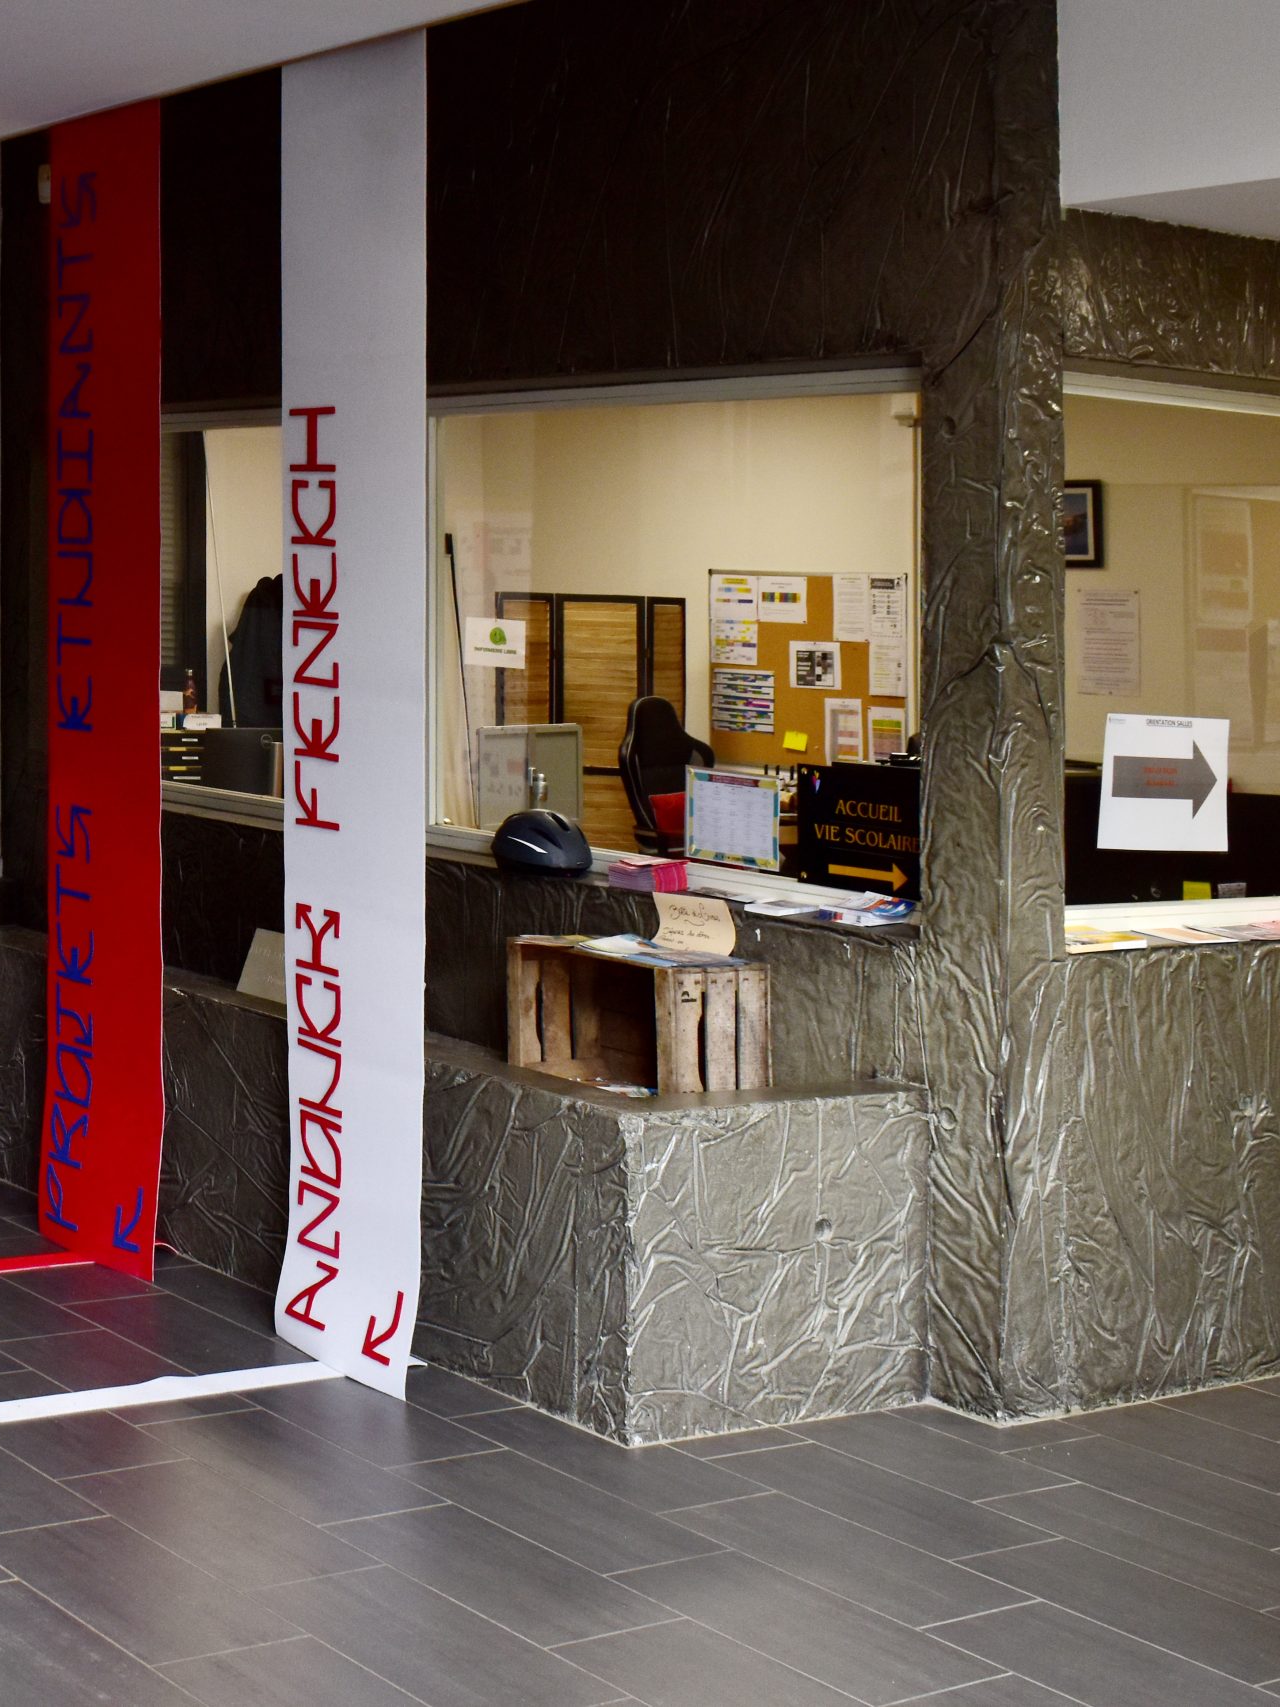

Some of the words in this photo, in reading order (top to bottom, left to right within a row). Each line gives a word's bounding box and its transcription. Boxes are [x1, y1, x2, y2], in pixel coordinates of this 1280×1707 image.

[288, 406, 340, 831] FENECH
[1146, 718, 1176, 727] ORIENTATION
[1176, 720, 1192, 728] SALLES
[835, 799, 902, 823] ACCUEIL
[814, 823, 840, 841] VIE
[845, 827, 921, 853] SCOLAIRE
